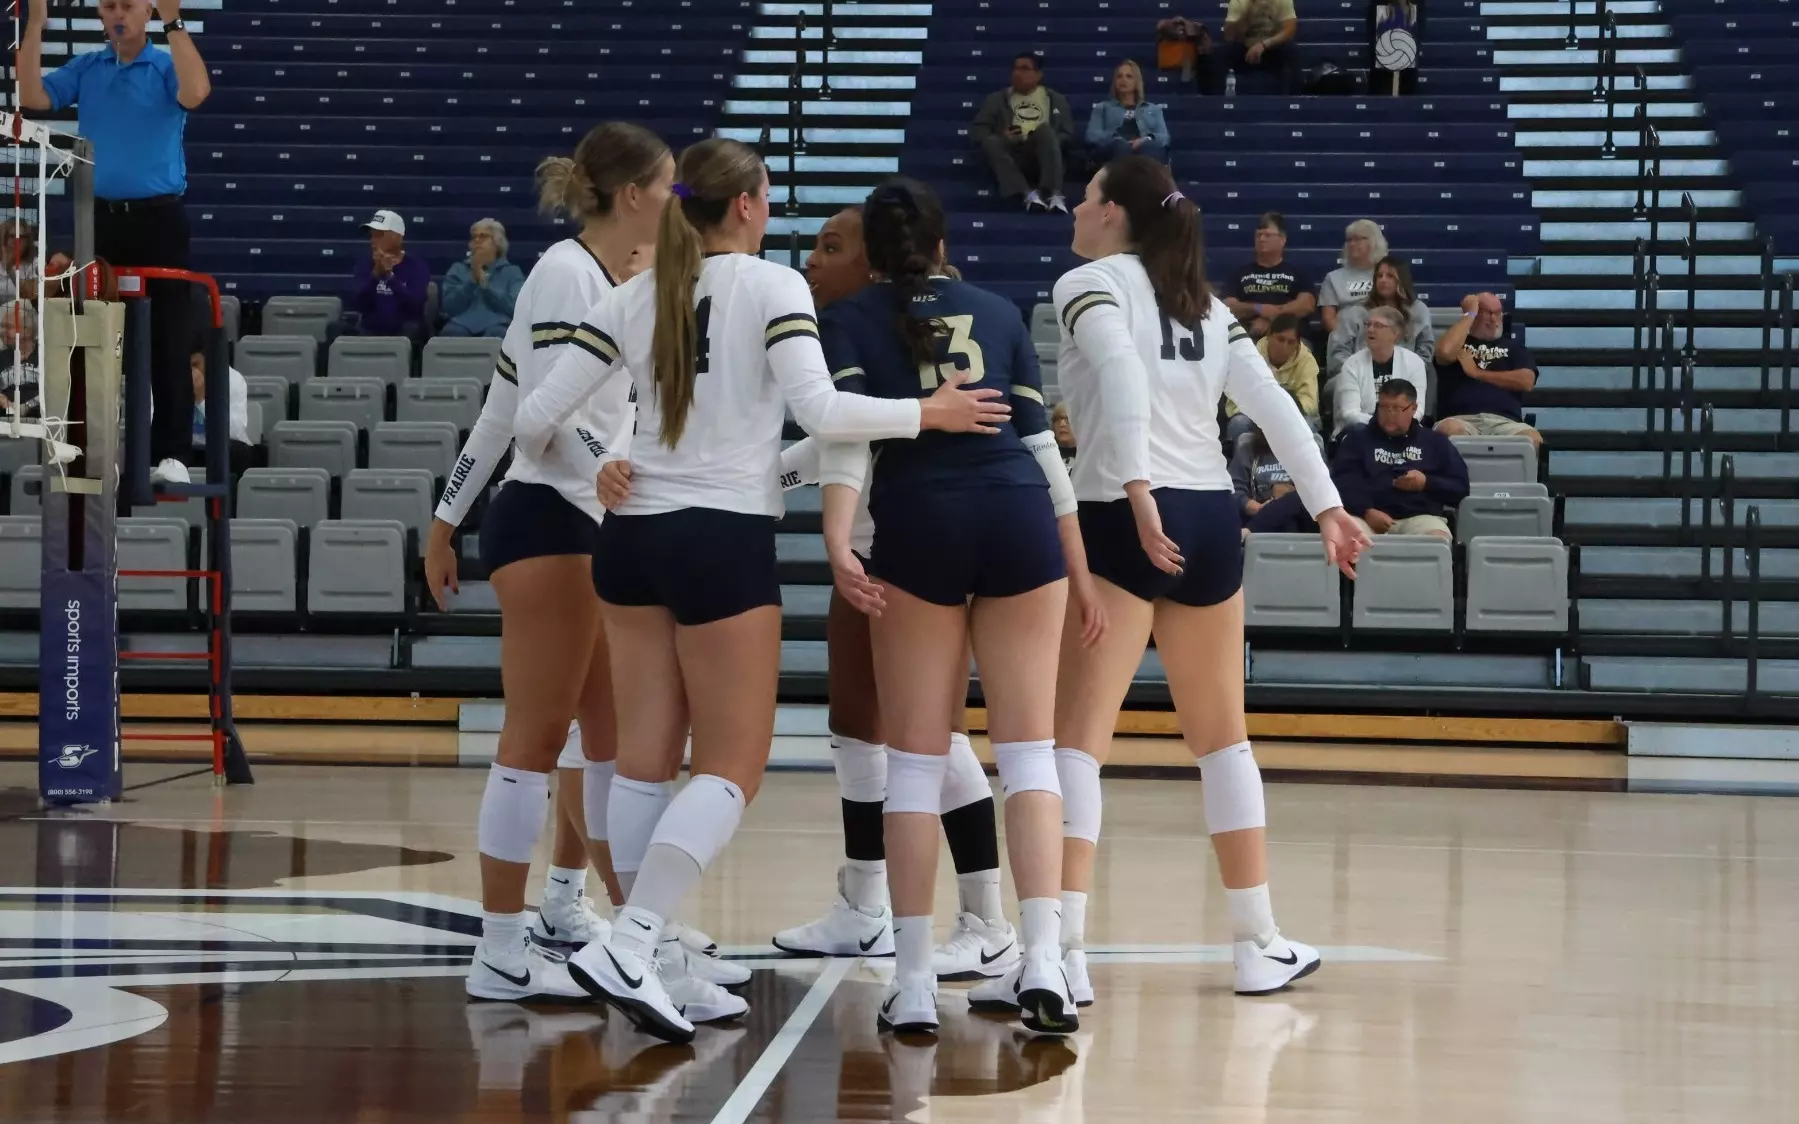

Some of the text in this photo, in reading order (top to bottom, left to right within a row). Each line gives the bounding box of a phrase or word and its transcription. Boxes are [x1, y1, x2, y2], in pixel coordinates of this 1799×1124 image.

[442, 453, 476, 506] PRAIRIE
[64, 600, 81, 720] sports imports
[47, 788, 64, 796] (800)
